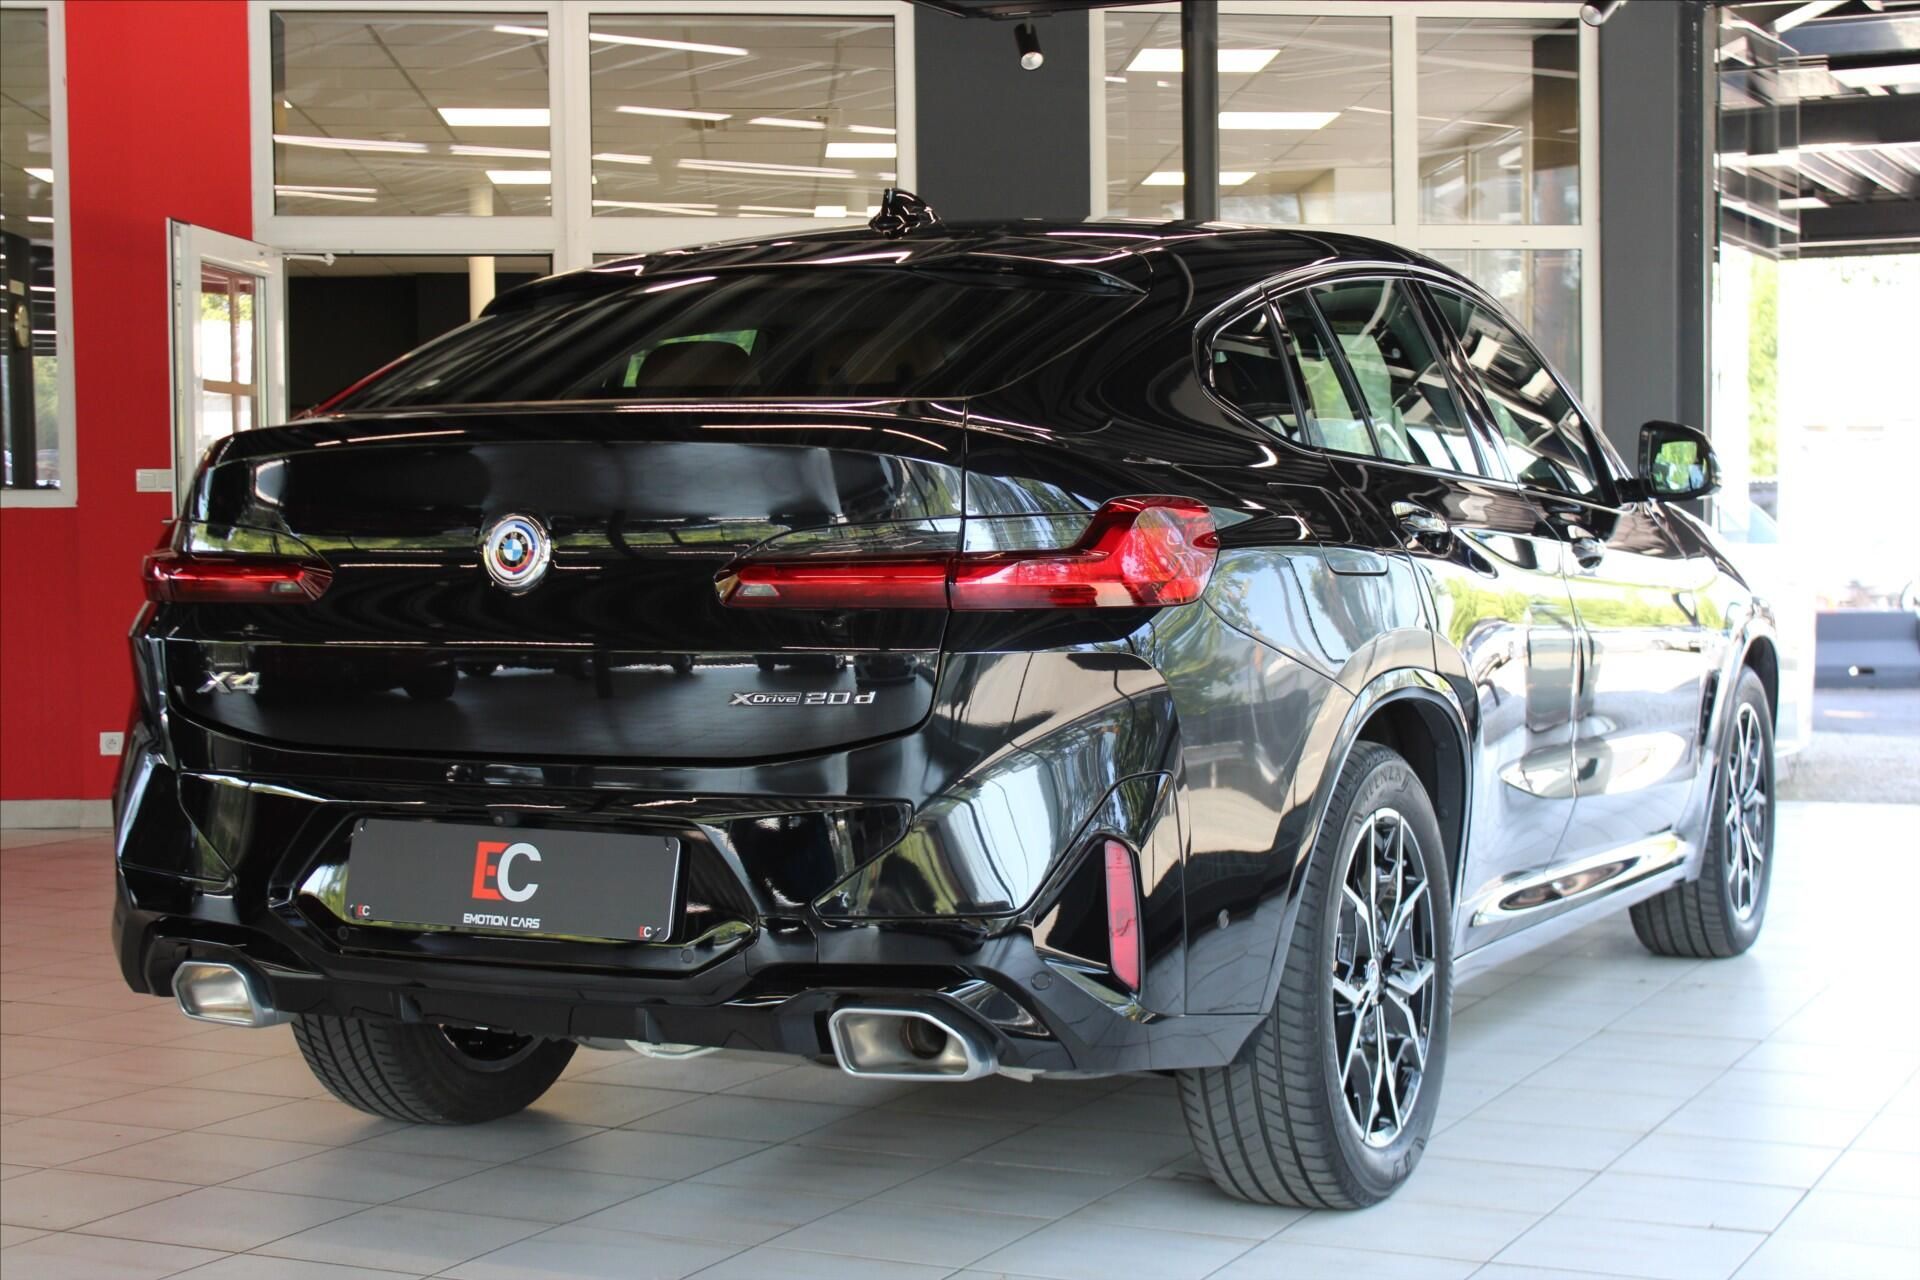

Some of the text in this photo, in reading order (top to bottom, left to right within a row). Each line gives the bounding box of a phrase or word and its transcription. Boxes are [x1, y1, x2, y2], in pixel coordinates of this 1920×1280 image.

[195, 670, 260, 695] X4
[472, 840, 542, 903] EC
[356, 904, 371, 918] EC
[463, 912, 541, 929] EMOTION CARS
